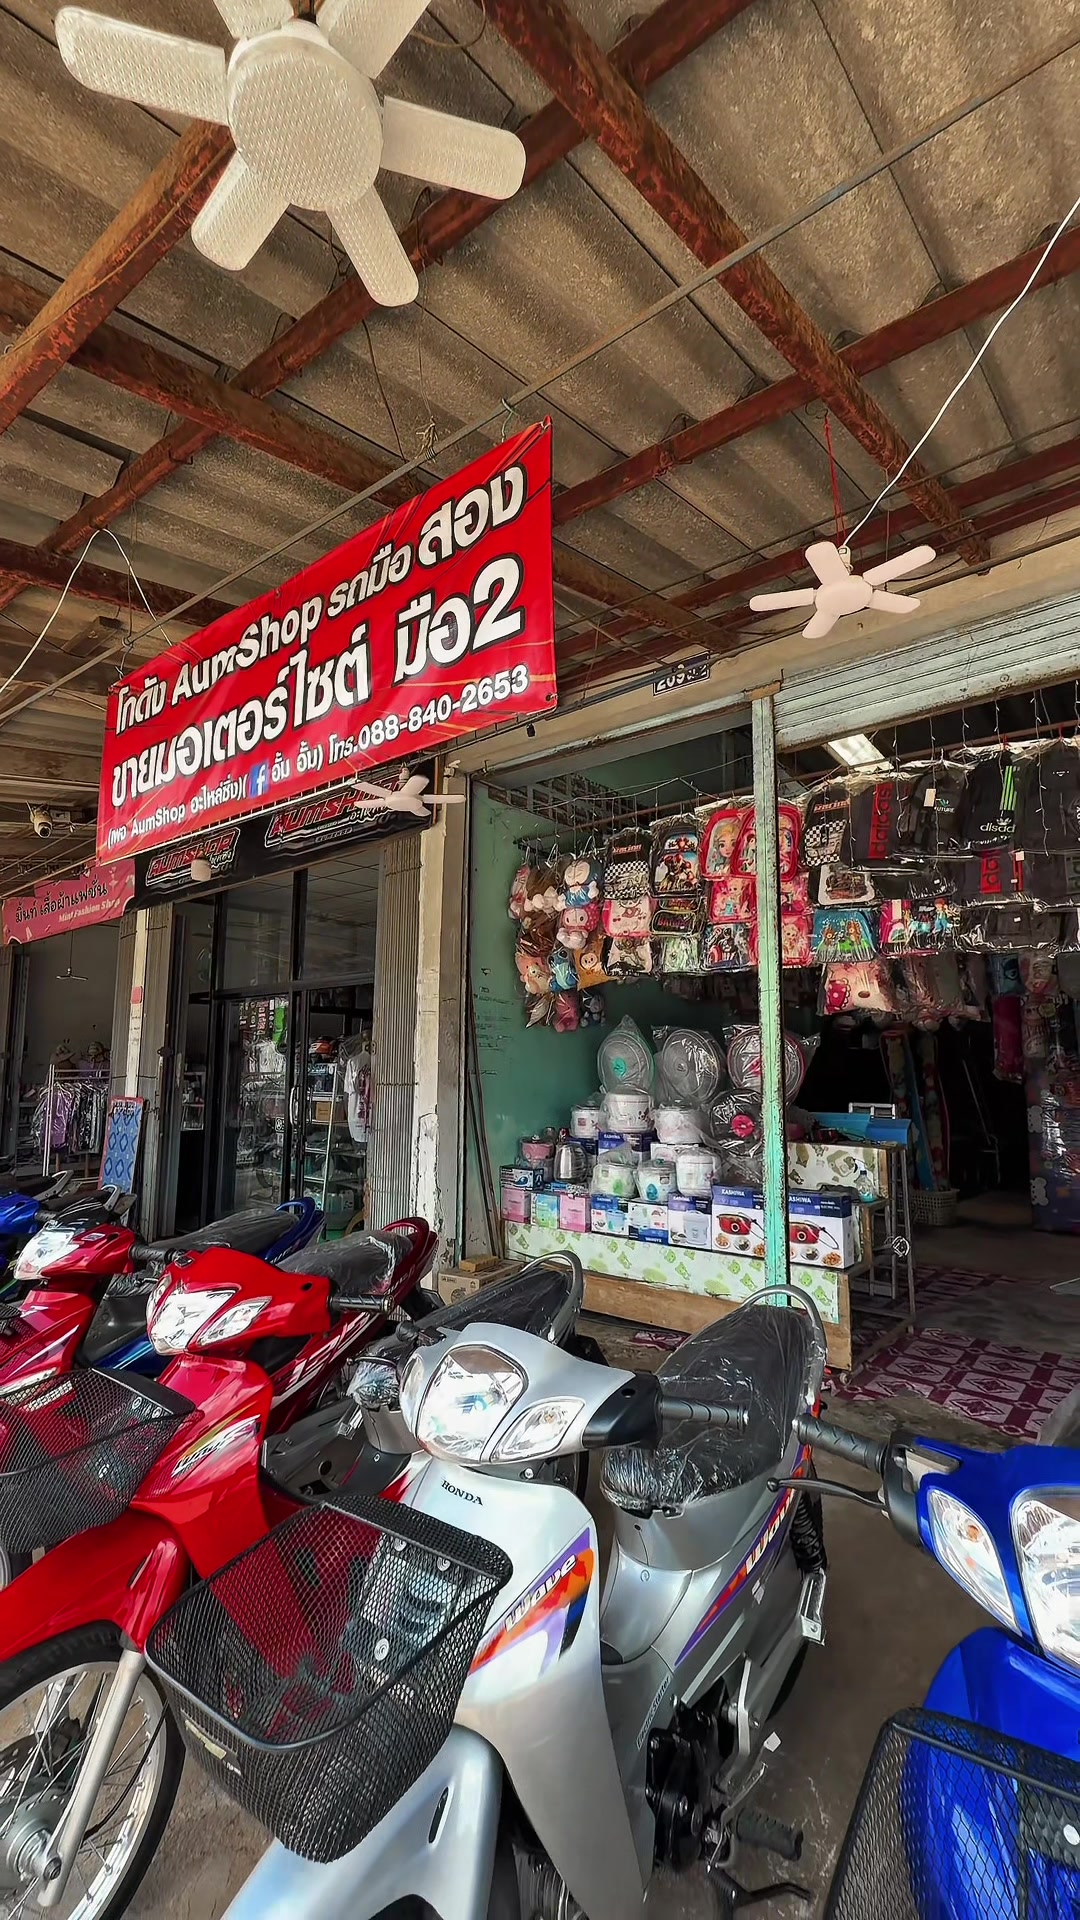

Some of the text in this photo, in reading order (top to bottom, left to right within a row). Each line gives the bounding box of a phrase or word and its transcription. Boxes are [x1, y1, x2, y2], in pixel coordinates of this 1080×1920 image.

[115, 466, 524, 735] โกดัง AumShop รถมือ สอง
[394, 558, 521, 682] มือ2
[131, 804, 186, 837] AumShop
[40, 874, 108, 916] เสื้อผ้าแฟชั่น
[58, 898, 120, 923] Mint Fashion Shop
[789, 1195, 812, 1204] ASHIWA
[441, 1479, 483, 1506] HONDA
[504, 1552, 577, 1633] Wave
